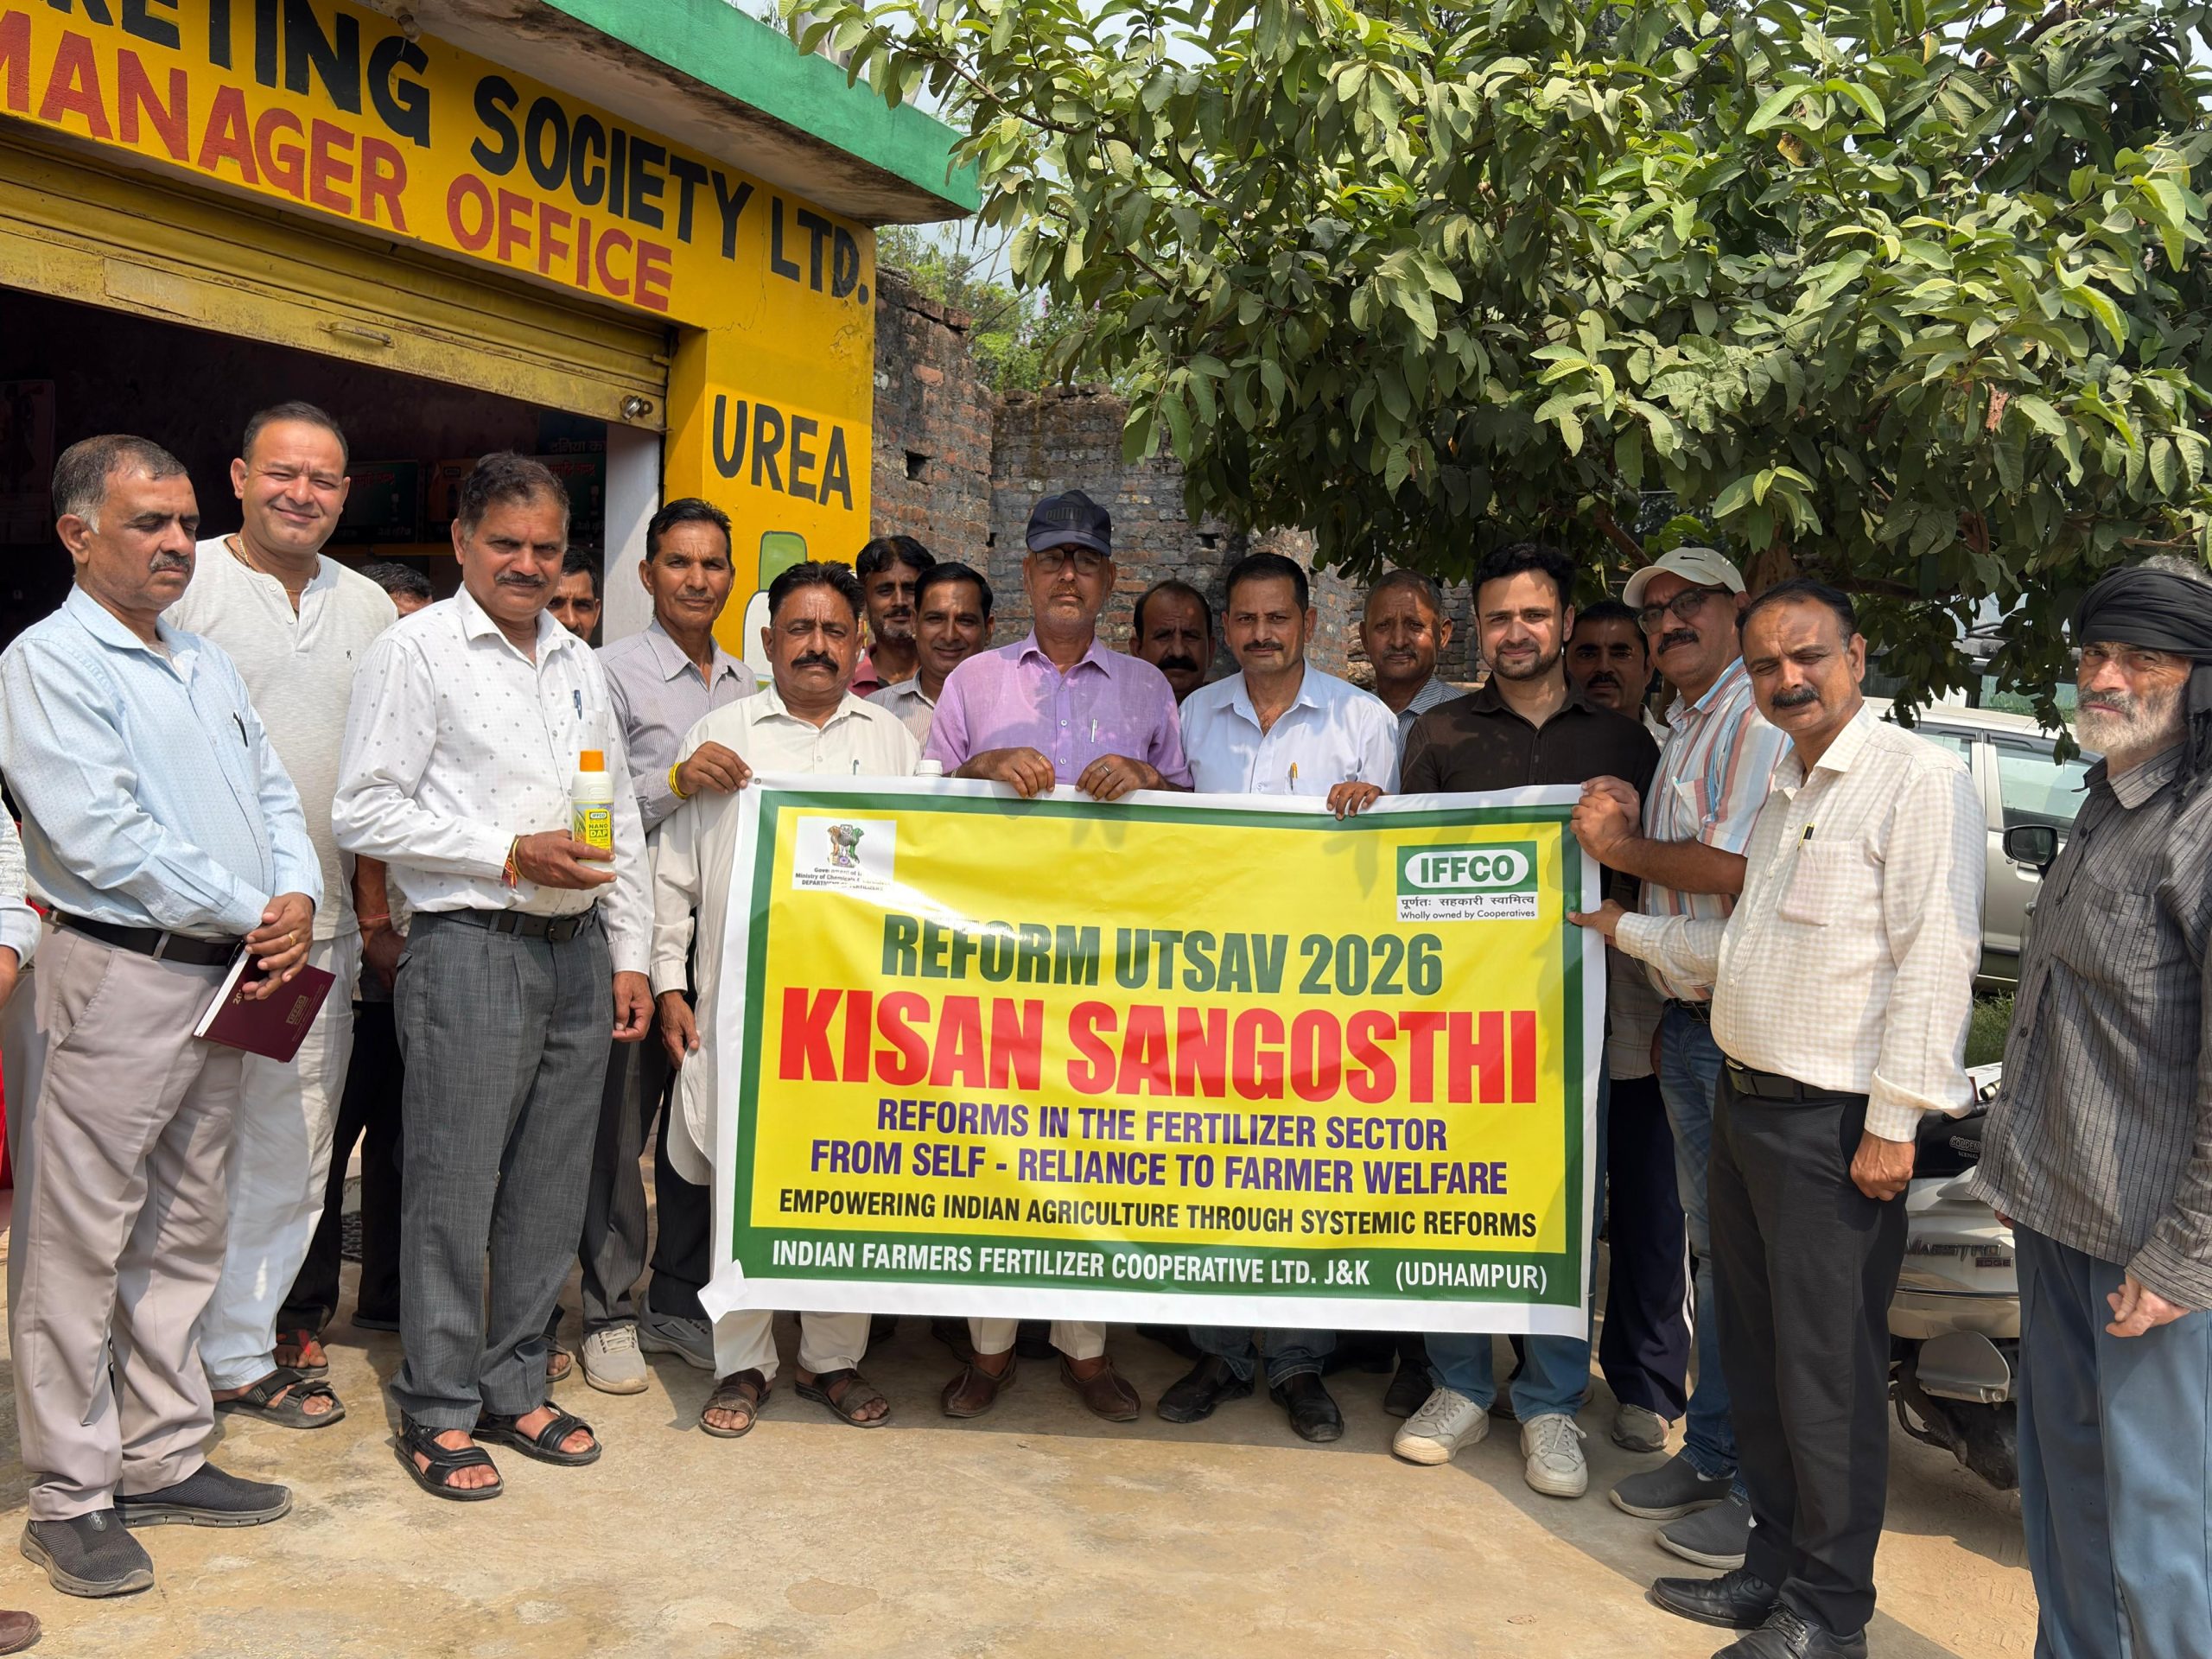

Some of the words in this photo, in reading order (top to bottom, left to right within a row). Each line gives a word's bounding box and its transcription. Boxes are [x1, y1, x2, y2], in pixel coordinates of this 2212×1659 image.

[471, 75, 754, 262] SOCIETY
[771, 198, 869, 306] LTD.
[446, 174, 673, 312] OFFICE
[713, 394, 854, 512] UREA
[1421, 855, 1515, 883] IFFCO
[1401, 896, 1432, 909] पूर्णतः
[1439, 895, 1483, 906] सहकारी
[1490, 894, 1535, 906] स्वामित्व
[1401, 911, 1430, 920] Wholly
[1433, 910, 1463, 919] owned
[1465, 910, 1475, 920] by
[1477, 909, 1535, 918] Cooperatives
[881, 914, 1101, 986] REFORM
[1115, 927, 1288, 994] UTSAV
[1299, 933, 1442, 996] 2026
[779, 987, 1044, 1091] KISAN
[1066, 1001, 1536, 1103] SANGOSTHI
[877, 1098, 1028, 1137] REFORMS
[1039, 1106, 1070, 1139] IN
[1078, 1107, 1137, 1141] THE
[1146, 1109, 1315, 1147] FERTILIZER
[1325, 1116, 1447, 1151] SECTOR
[810, 1139, 901, 1175] FROM
[912, 1141, 986, 1178] SELF
[1018, 1147, 1166, 1185] RELIANCE
[1176, 1154, 1214, 1189] TO
[1224, 1155, 1353, 1193] FARMER
[1363, 1160, 1508, 1195] WELFARE
[779, 1188, 936, 1218] EMPOWERING
[943, 1194, 1020, 1222] INDIAN
[1026, 1198, 1179, 1228] AGRICULTURE
[1186, 1204, 1293, 1233] THROUGH
[1300, 1209, 1415, 1235] SYSTEMIC
[1424, 1211, 1537, 1237] REFORMS
[772, 1240, 855, 1268] INDIAN
[861, 1243, 972, 1273] FARMERS
[979, 1246, 1104, 1277] FERTILIZER
[1111, 1253, 1263, 1284] COOPERATIVE
[1271, 1260, 1316, 1285] LTD.
[1323, 1260, 1370, 1286] J&K
[1395, 1261, 1548, 1295] (UDHAMPUR)
[1907, 1236, 2002, 1262] MAESTRO
[1976, 1257, 2012, 1268] EDGE
